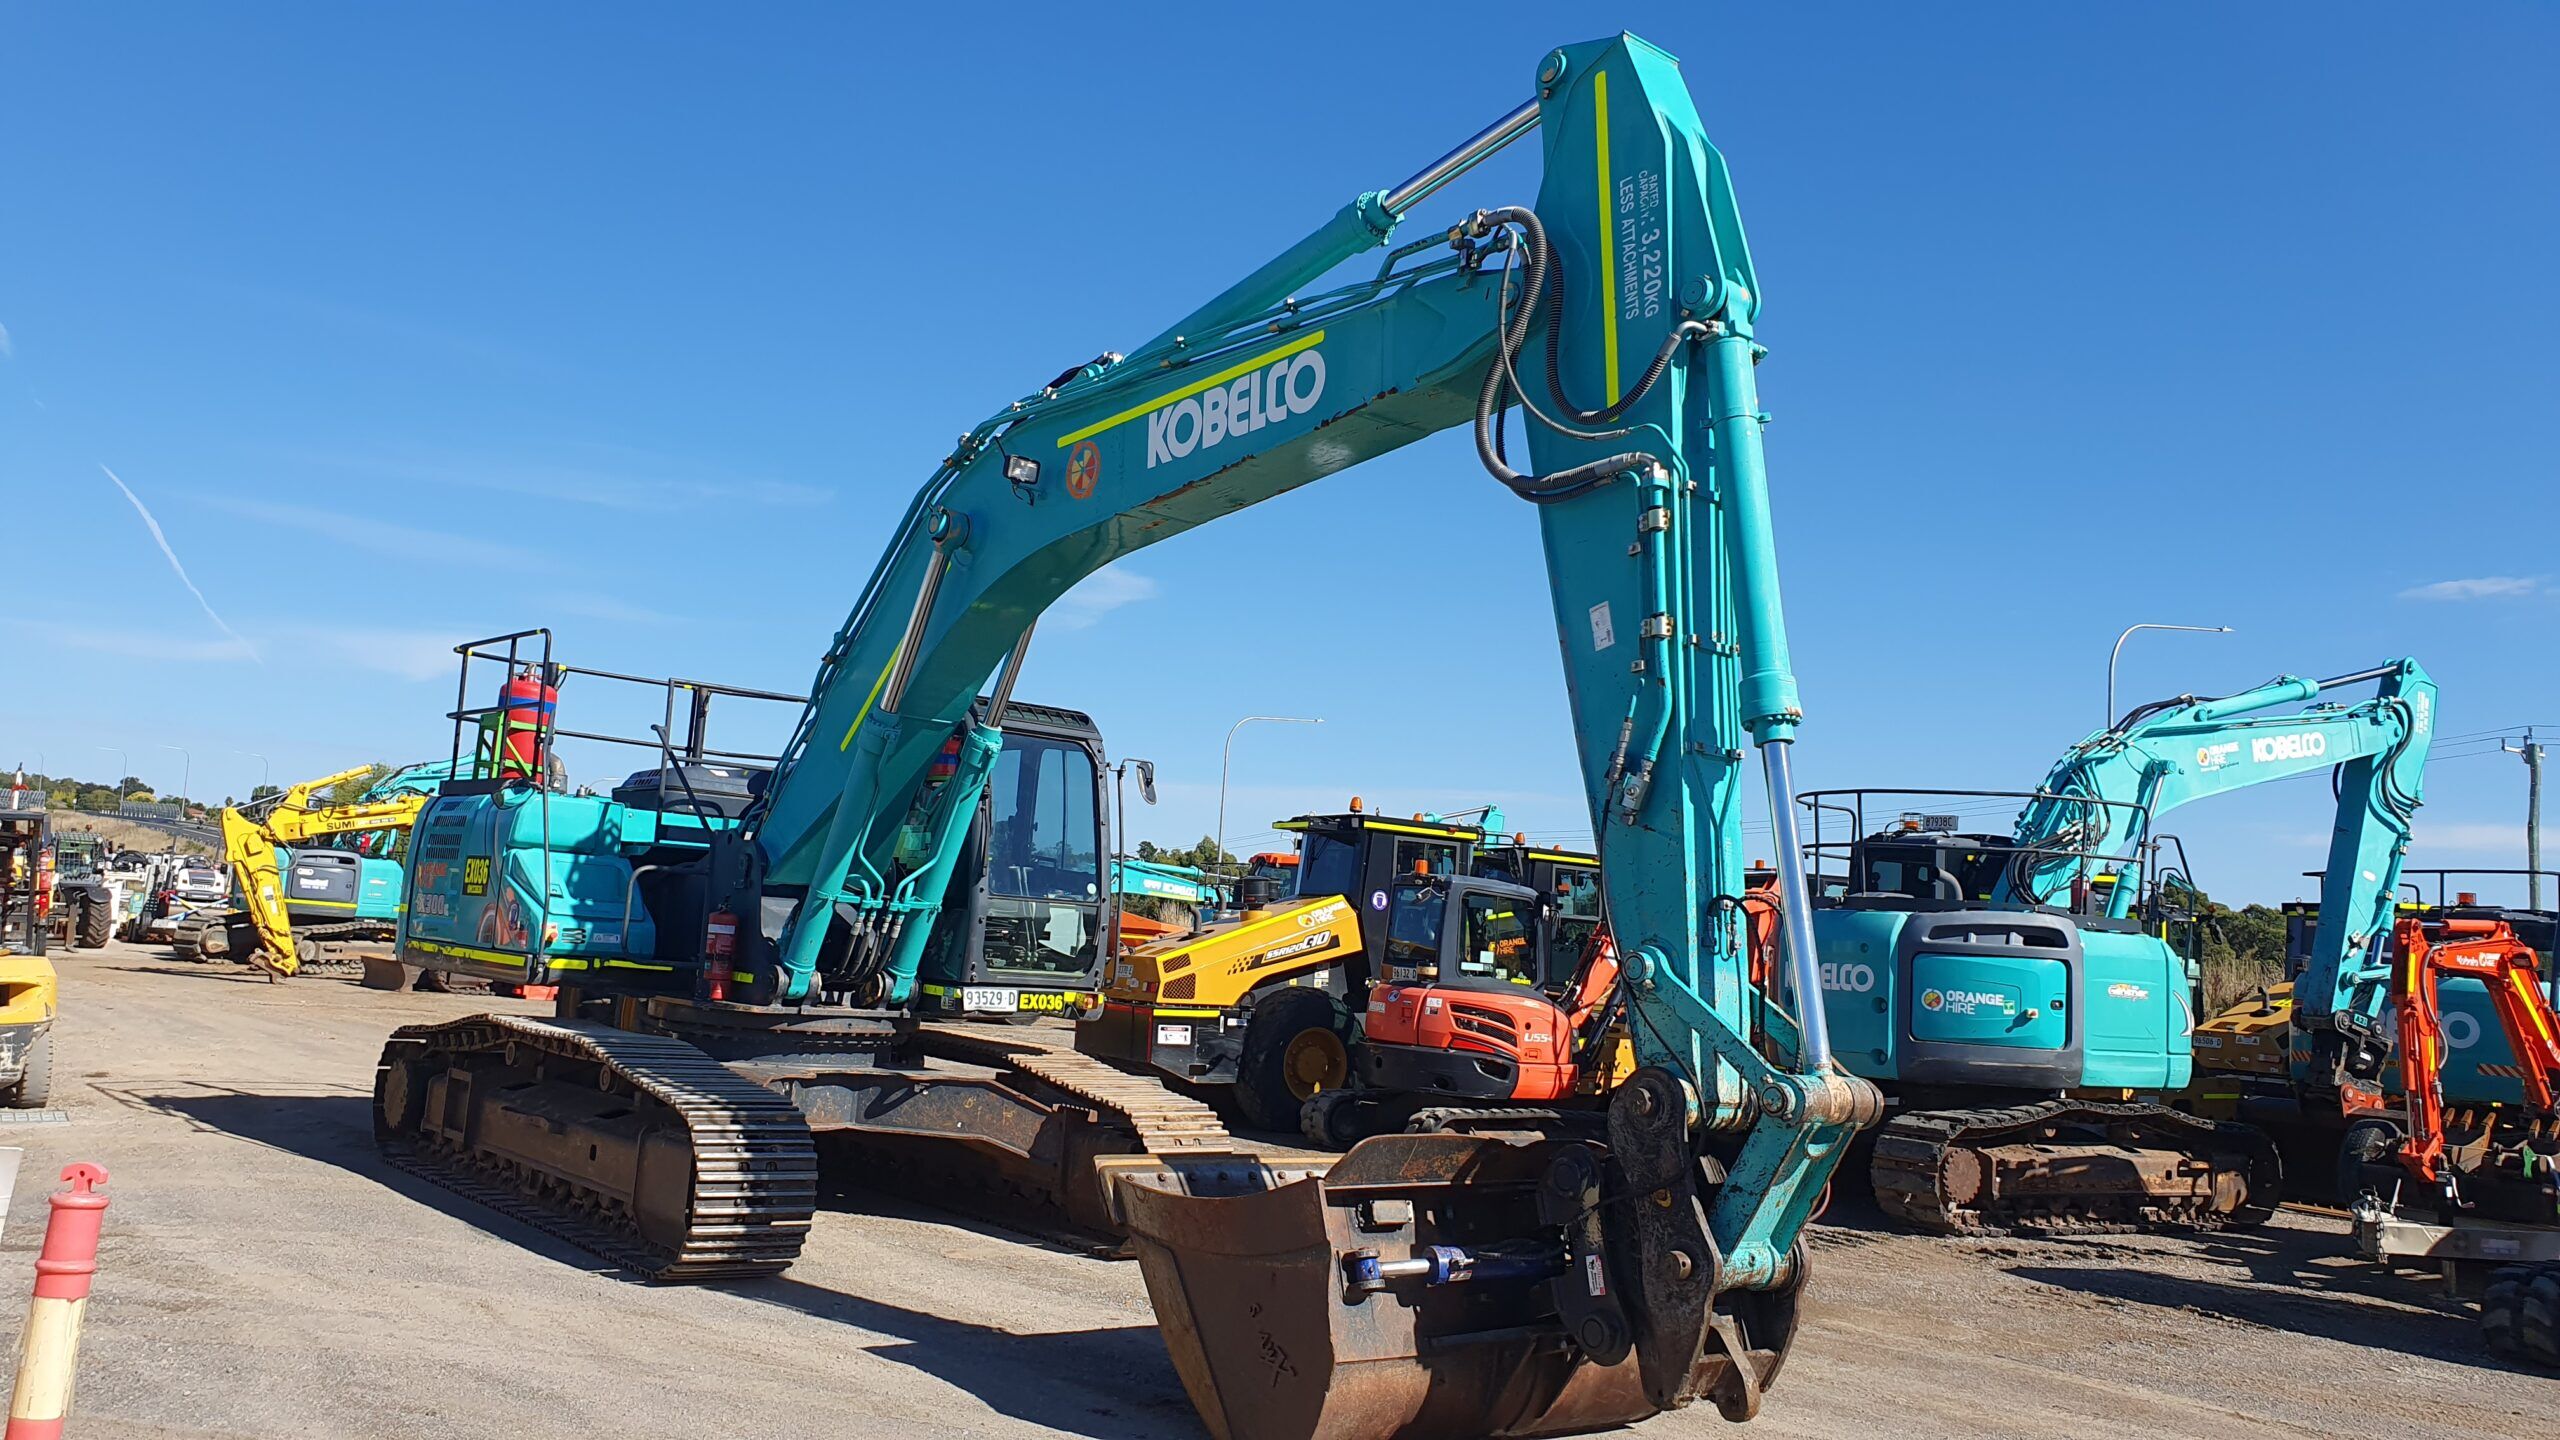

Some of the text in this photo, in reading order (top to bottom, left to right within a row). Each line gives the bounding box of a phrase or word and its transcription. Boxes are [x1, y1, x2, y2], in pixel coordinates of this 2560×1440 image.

[1648, 173, 1659, 208] RATED
[1619, 176, 1640, 320] LESS ATTACHMENTS
[1639, 228, 1662, 318] 3,220KG
[1147, 350, 1326, 469] KOBELCO
[2251, 731, 2326, 763] KOBELCO
[465, 858, 490, 884] EX036
[1500, 937, 1527, 947] ORANGE
[1500, 946, 1515, 954] HIRE
[966, 991, 1003, 1006] 93529
[1019, 993, 1063, 1010] EX036
[1945, 1002, 1976, 1015] HIRE
[1946, 990, 2005, 1006] ORANGE
